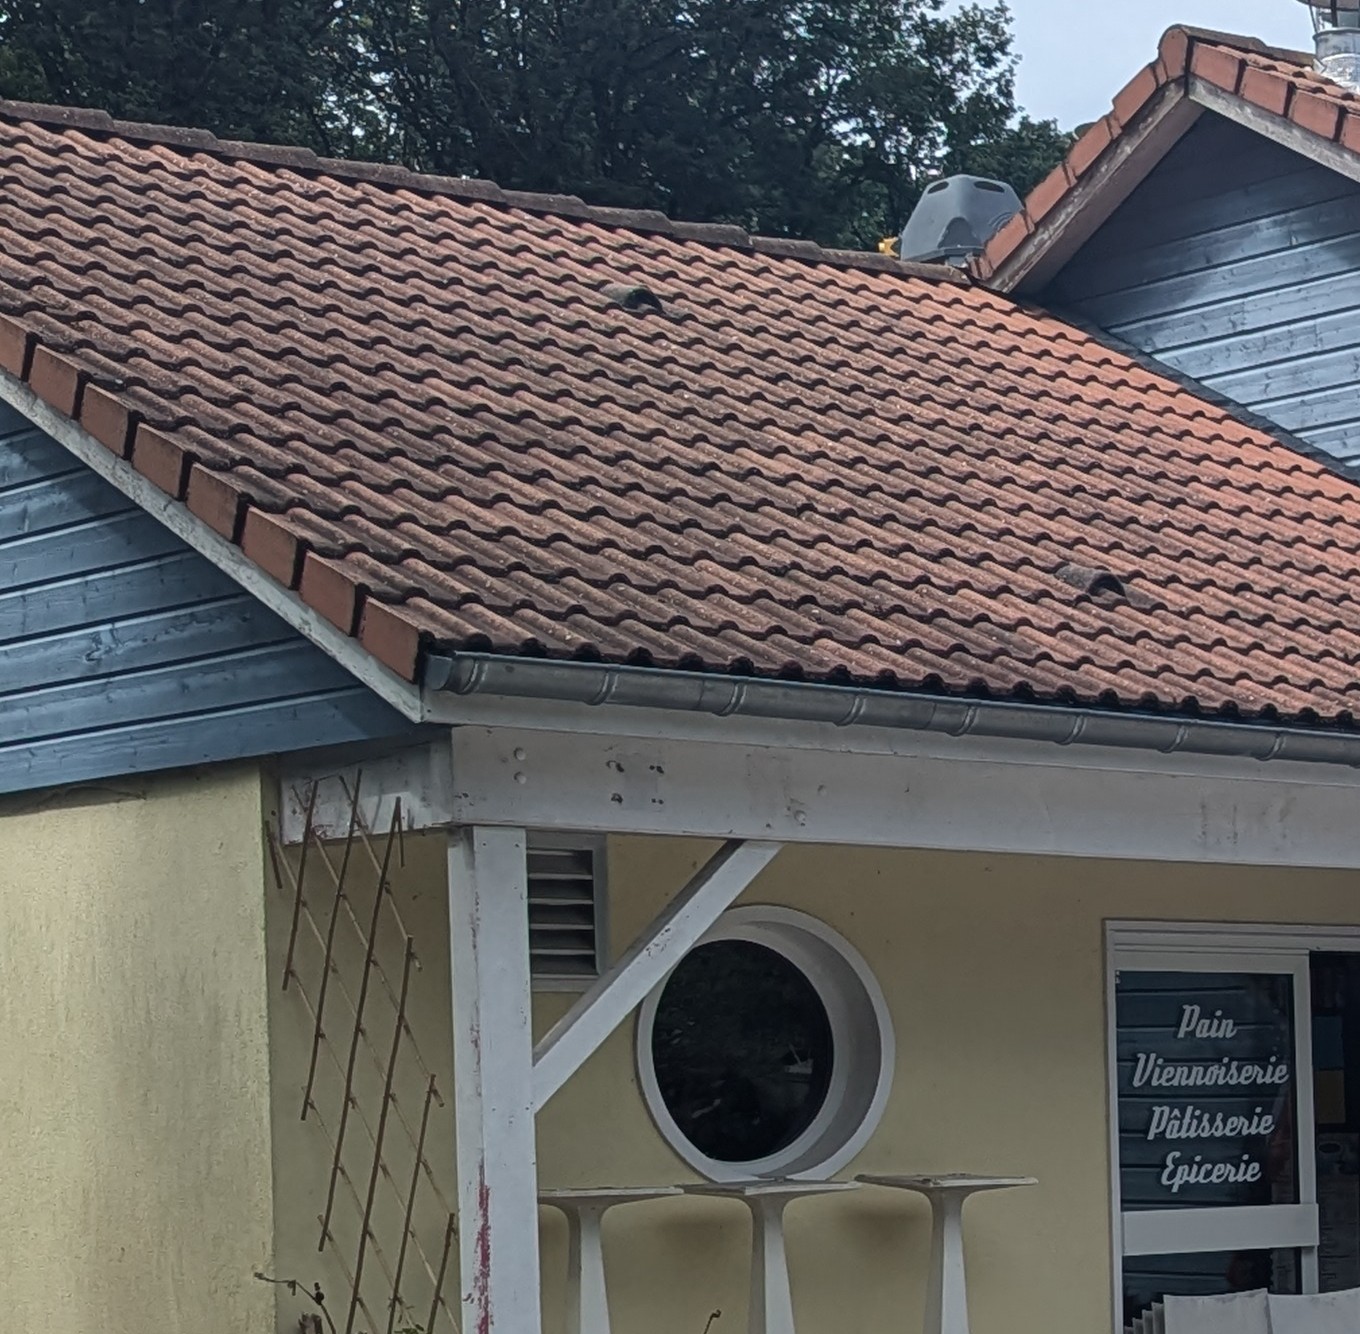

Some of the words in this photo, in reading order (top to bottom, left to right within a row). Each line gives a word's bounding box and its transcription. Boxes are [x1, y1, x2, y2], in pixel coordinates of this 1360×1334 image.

[1177, 1004, 1238, 1039] Pain
[1132, 1053, 1290, 1088] Viennoiserie
[1147, 1105, 1276, 1141] Pâtisserie
[1161, 1151, 1263, 1193] Epicerie
